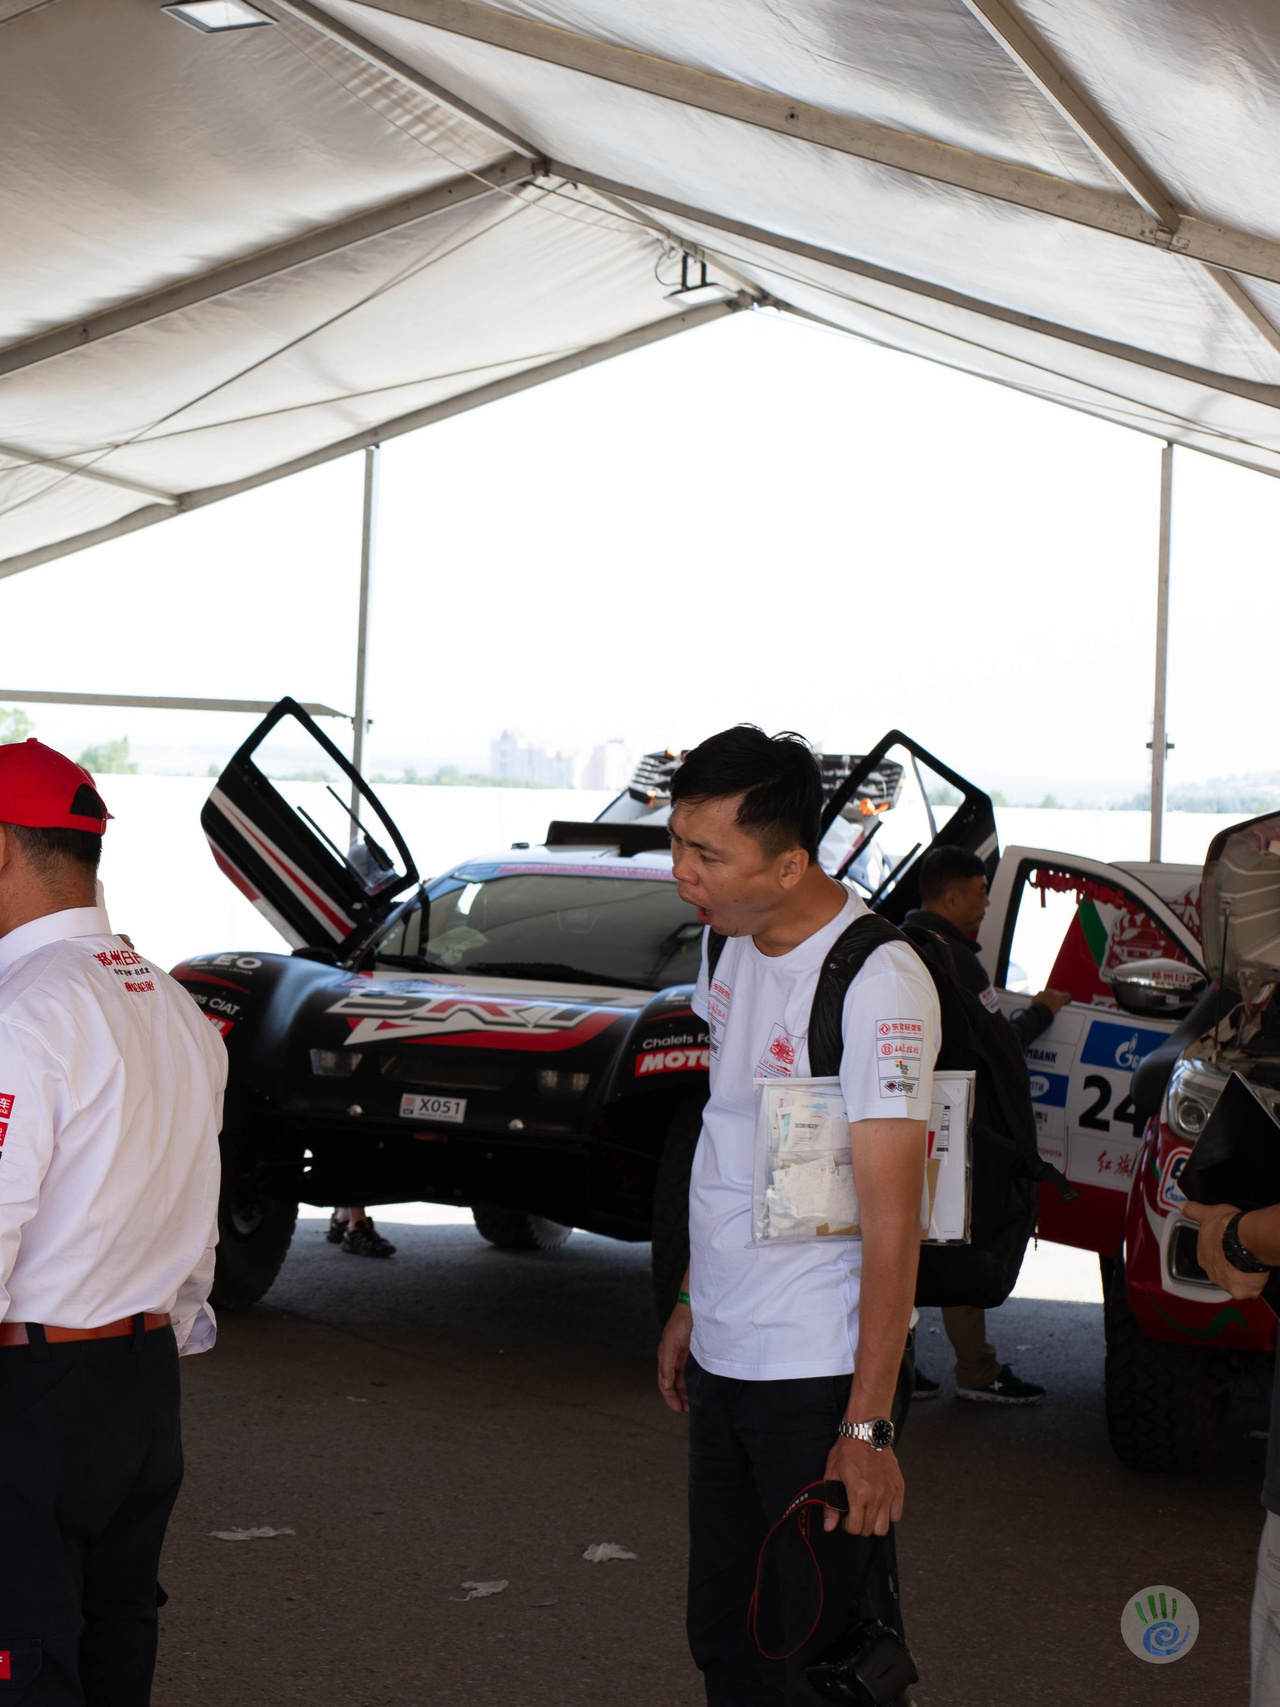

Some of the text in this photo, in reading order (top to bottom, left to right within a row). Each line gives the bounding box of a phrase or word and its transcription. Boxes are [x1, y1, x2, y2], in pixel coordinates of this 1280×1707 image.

[190, 954, 263, 969] LEO
[209, 997, 241, 1016] CIAT
[642, 1034, 694, 1050] Chalets
[419, 1097, 461, 1115] X051
[1078, 1074, 1146, 1138] 24
